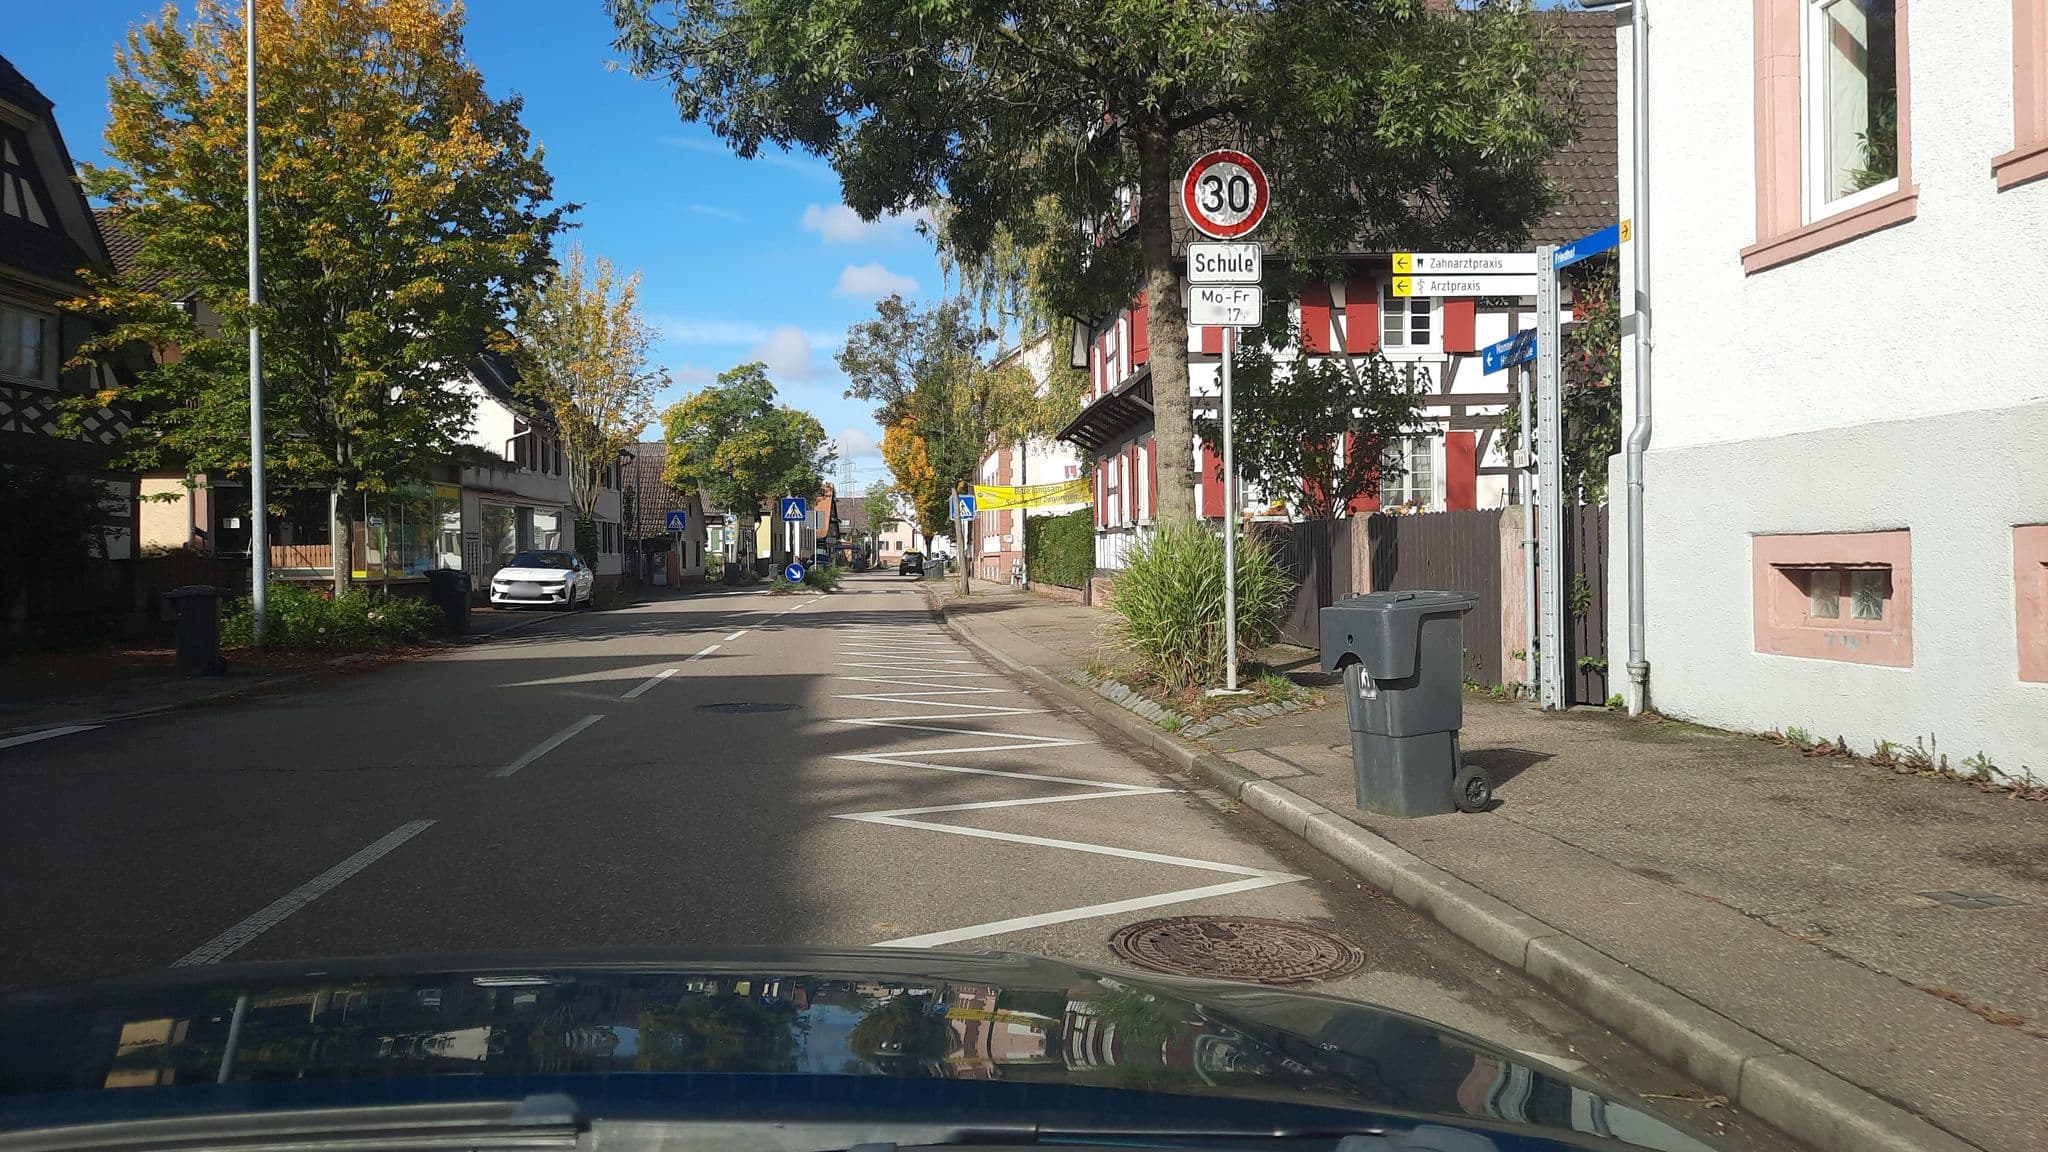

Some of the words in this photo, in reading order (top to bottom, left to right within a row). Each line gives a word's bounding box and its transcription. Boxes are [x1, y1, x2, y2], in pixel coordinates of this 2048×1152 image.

[1202, 174, 1250, 213] 30
[1195, 253, 1254, 272] Schule
[1430, 258, 1503, 270] Zahnarztpraxis
[1430, 281, 1481, 293] Arztpraxis
[1201, 290, 1249, 303] Mo-Fr
